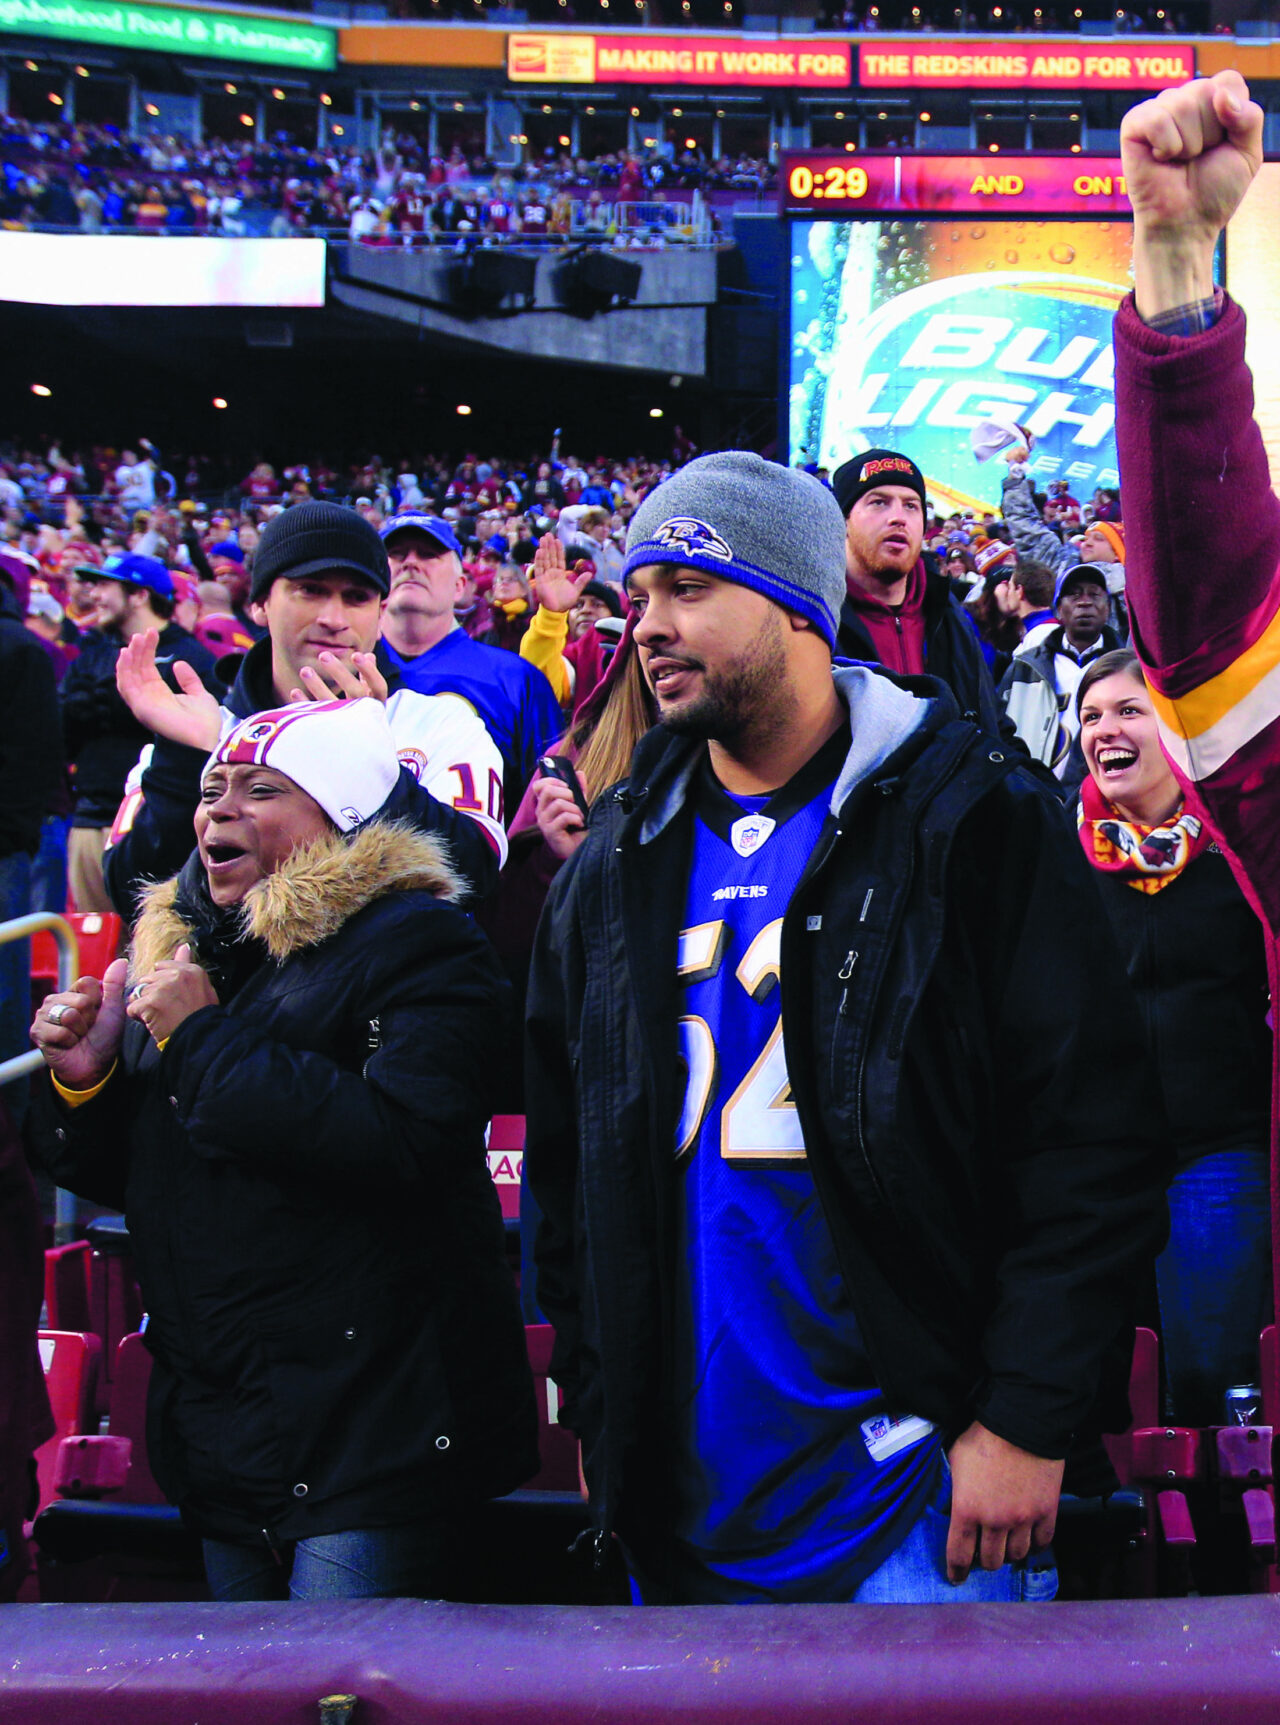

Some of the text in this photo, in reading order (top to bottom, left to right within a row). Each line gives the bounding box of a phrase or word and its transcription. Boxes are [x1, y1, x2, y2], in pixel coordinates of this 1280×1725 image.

[127, 11, 183, 39] Food
[187, 18, 211, 42] &
[213, 21, 329, 61] Pharmacy
[600, 48, 694, 72] MAKING
[695, 50, 719, 71] IT
[721, 50, 796, 73] WORK
[799, 53, 846, 75] FOR
[864, 54, 1189, 77] THE REDSKINS AND FOR YOU.
[789, 166, 868, 199] 0:29
[970, 175, 1024, 196] AND
[1073, 176, 1112, 196] ON
[852, 372, 1116, 448] LIGH
[1032, 455, 1119, 486] EER
[447, 763, 504, 824] 10
[711, 885, 769, 901] RAVENS
